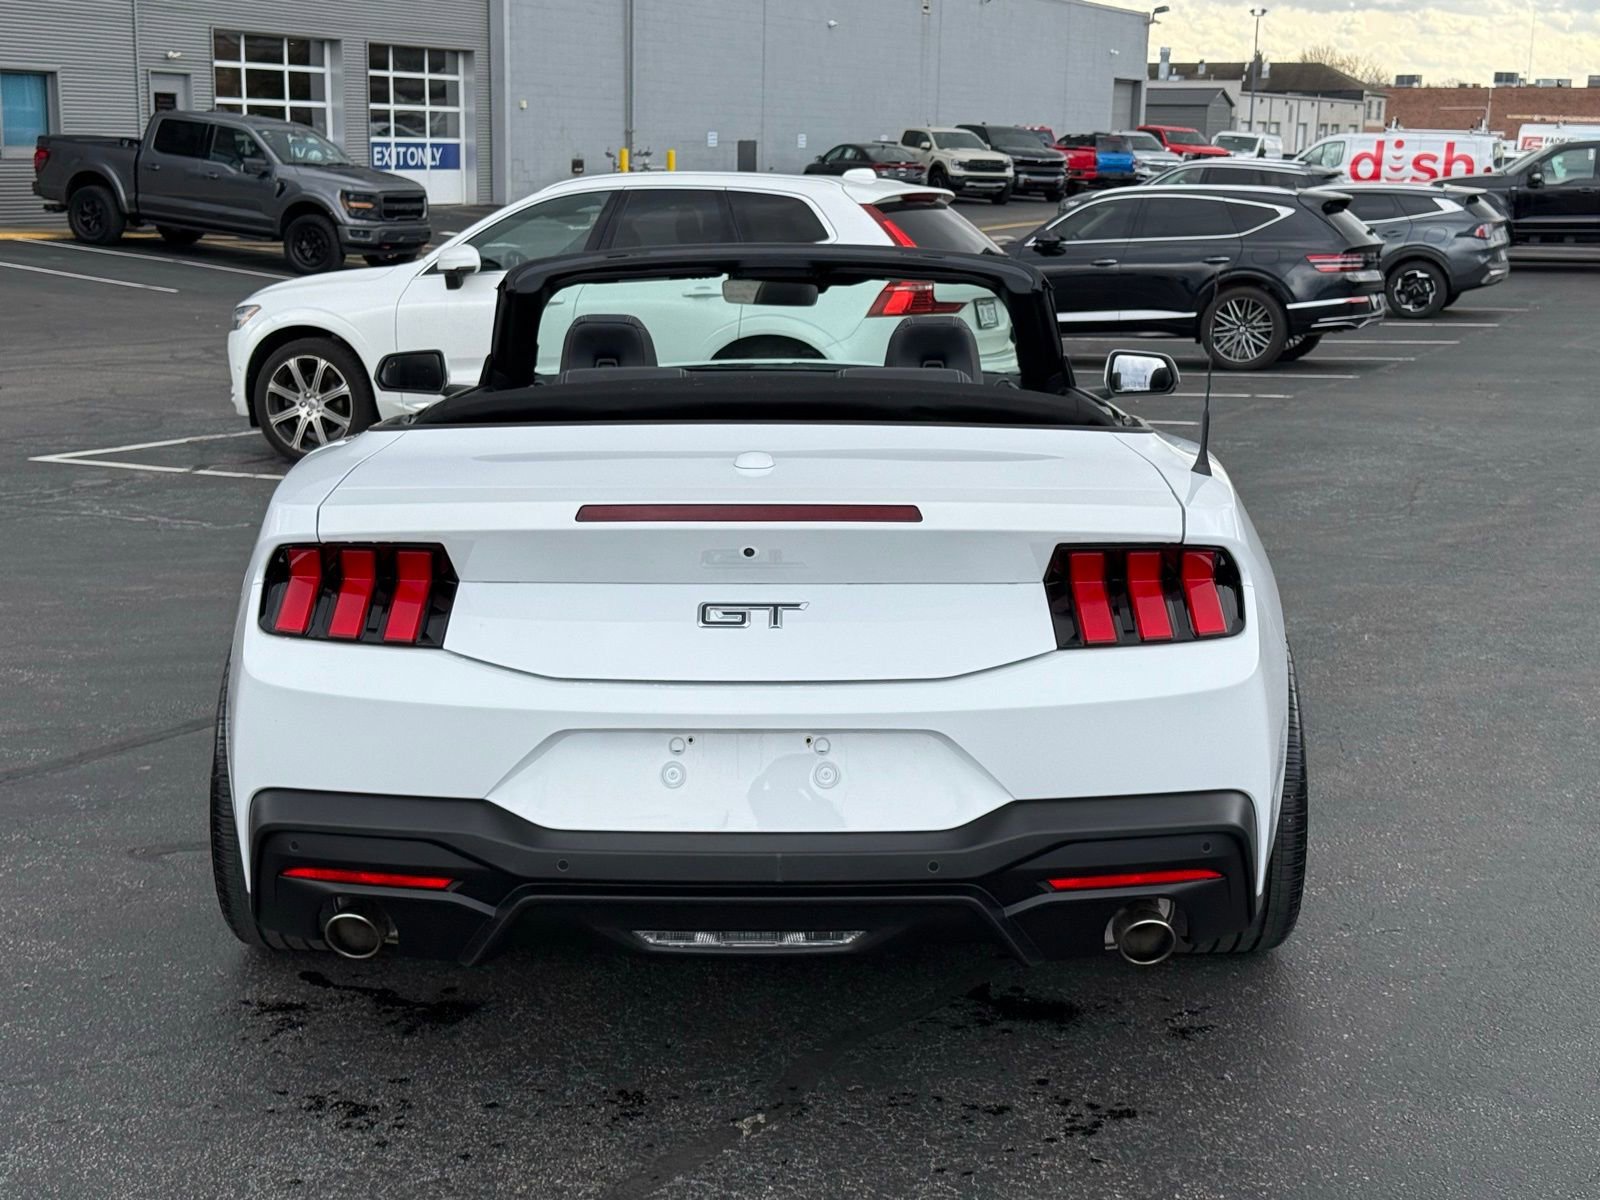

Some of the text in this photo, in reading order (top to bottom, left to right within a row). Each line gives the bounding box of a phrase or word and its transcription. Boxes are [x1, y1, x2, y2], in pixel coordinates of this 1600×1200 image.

[373, 146, 443, 167] EXIT ONLY
[1350, 140, 1475, 182] dish
[697, 601, 810, 629] GT
